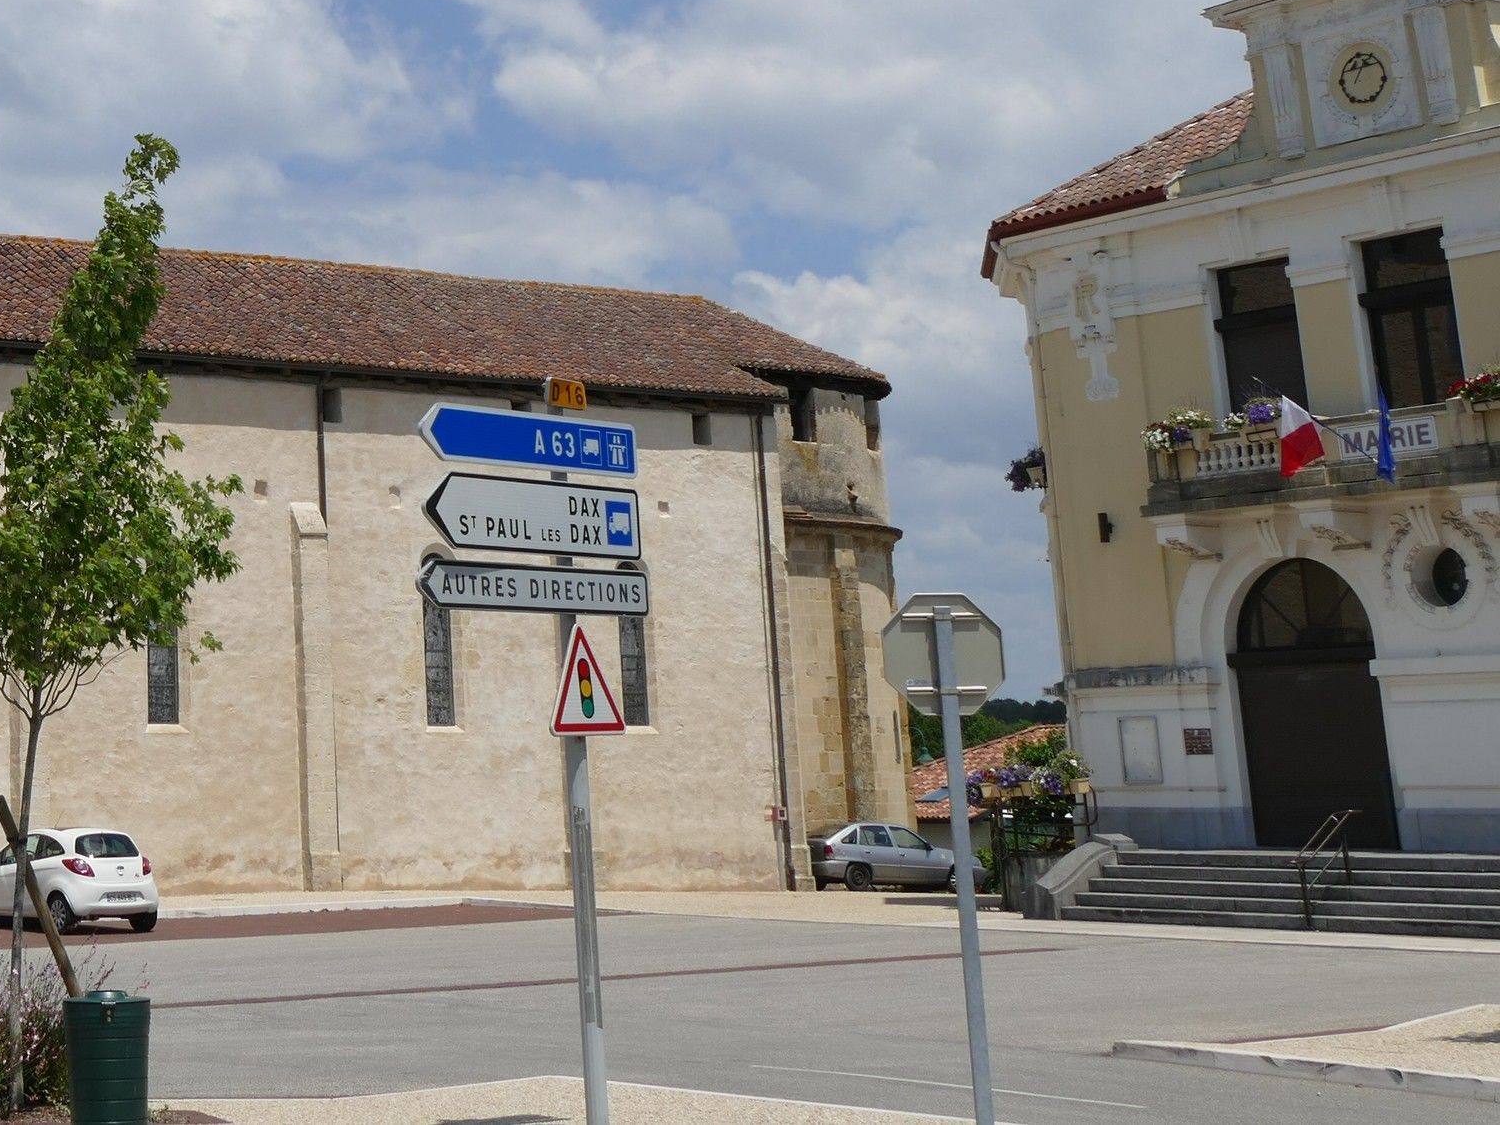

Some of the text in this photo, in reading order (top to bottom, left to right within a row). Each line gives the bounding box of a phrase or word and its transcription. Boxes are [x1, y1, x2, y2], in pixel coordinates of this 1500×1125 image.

[552, 382, 584, 405] D 16
[534, 429, 575, 458] A 63
[1343, 423, 1432, 454] MARIE
[569, 496, 600, 518] DAX
[486, 516, 532, 541] PAUL
[541, 528, 561, 543] LES
[571, 524, 602, 546] DAX
[442, 574, 641, 604] AUTRES DIRECTIONS
